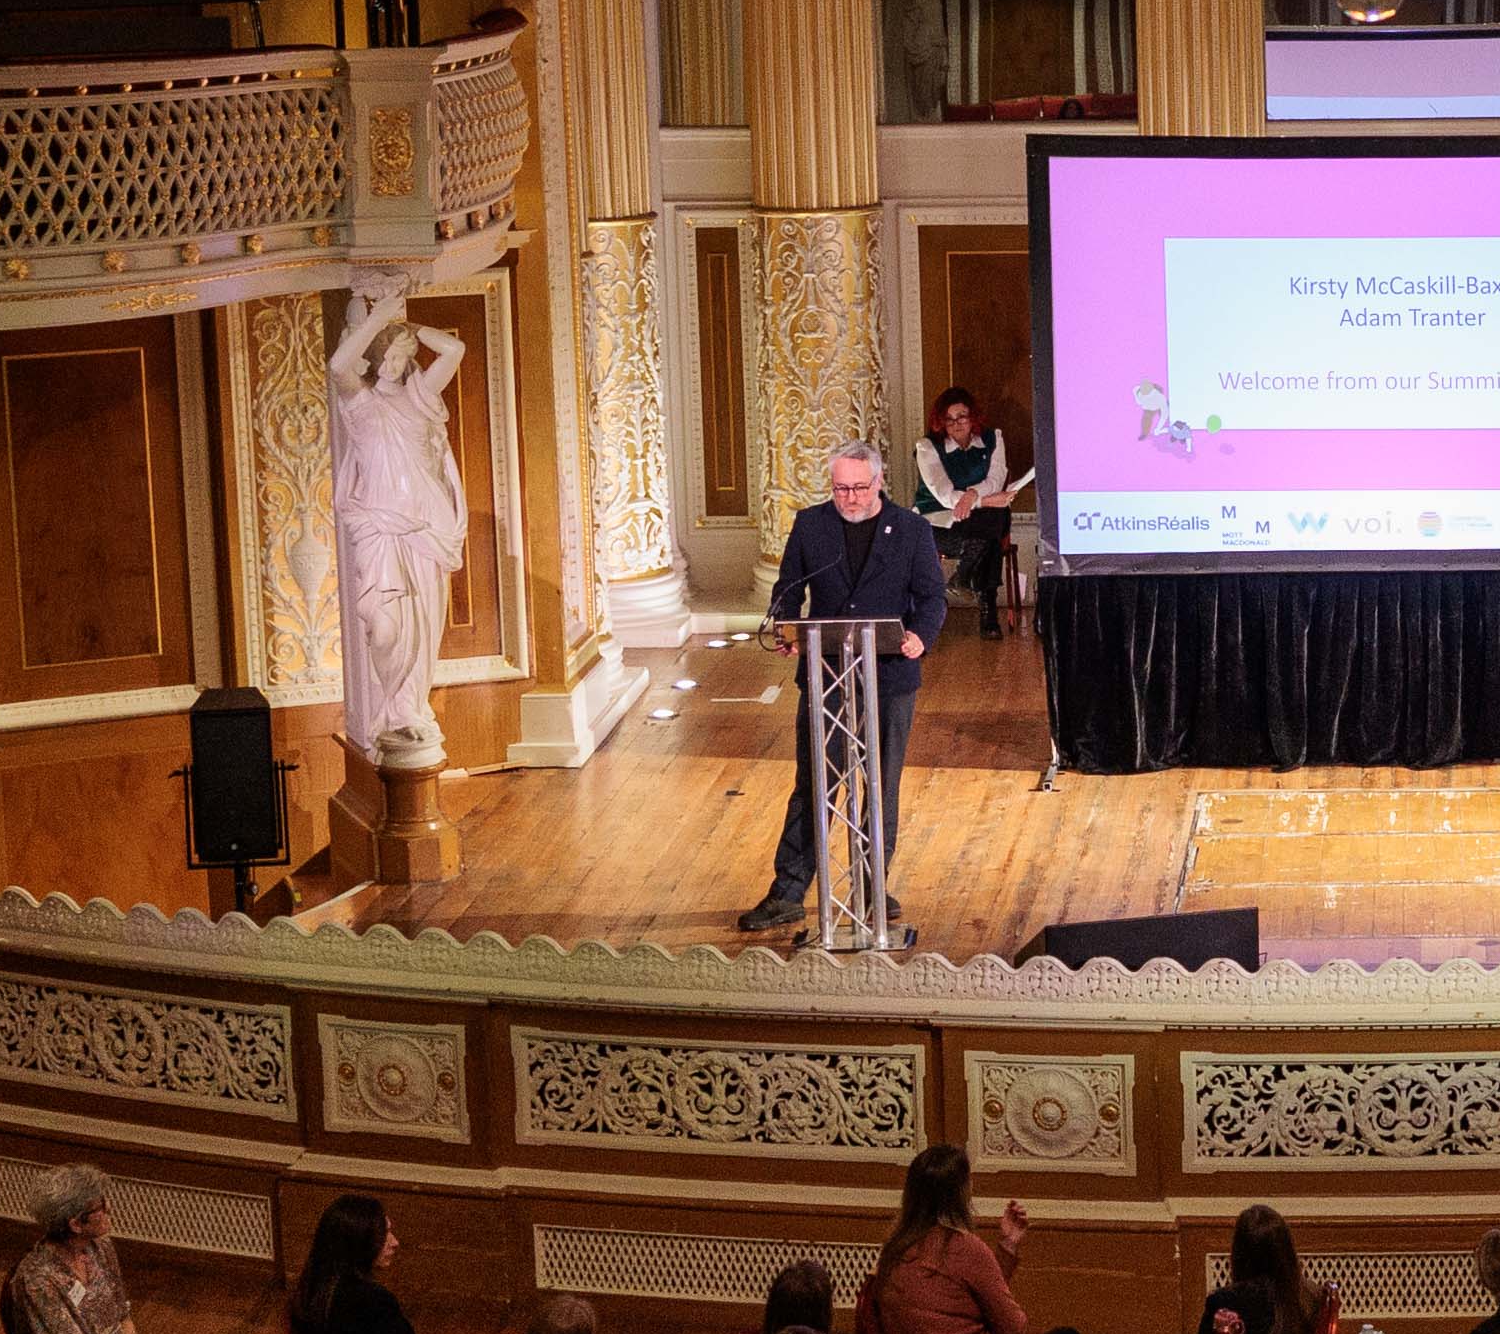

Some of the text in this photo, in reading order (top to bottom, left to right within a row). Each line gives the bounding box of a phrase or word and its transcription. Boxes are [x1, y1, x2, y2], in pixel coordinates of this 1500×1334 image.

[1289, 276, 1349, 299] Kirsty
[1338, 308, 1486, 327] Adam Tranter
[1218, 371, 1319, 390] Welcome
[1326, 370, 1378, 390] from
[1385, 375, 1421, 390] our
[1101, 516, 1211, 531] AtkinsRéalis
